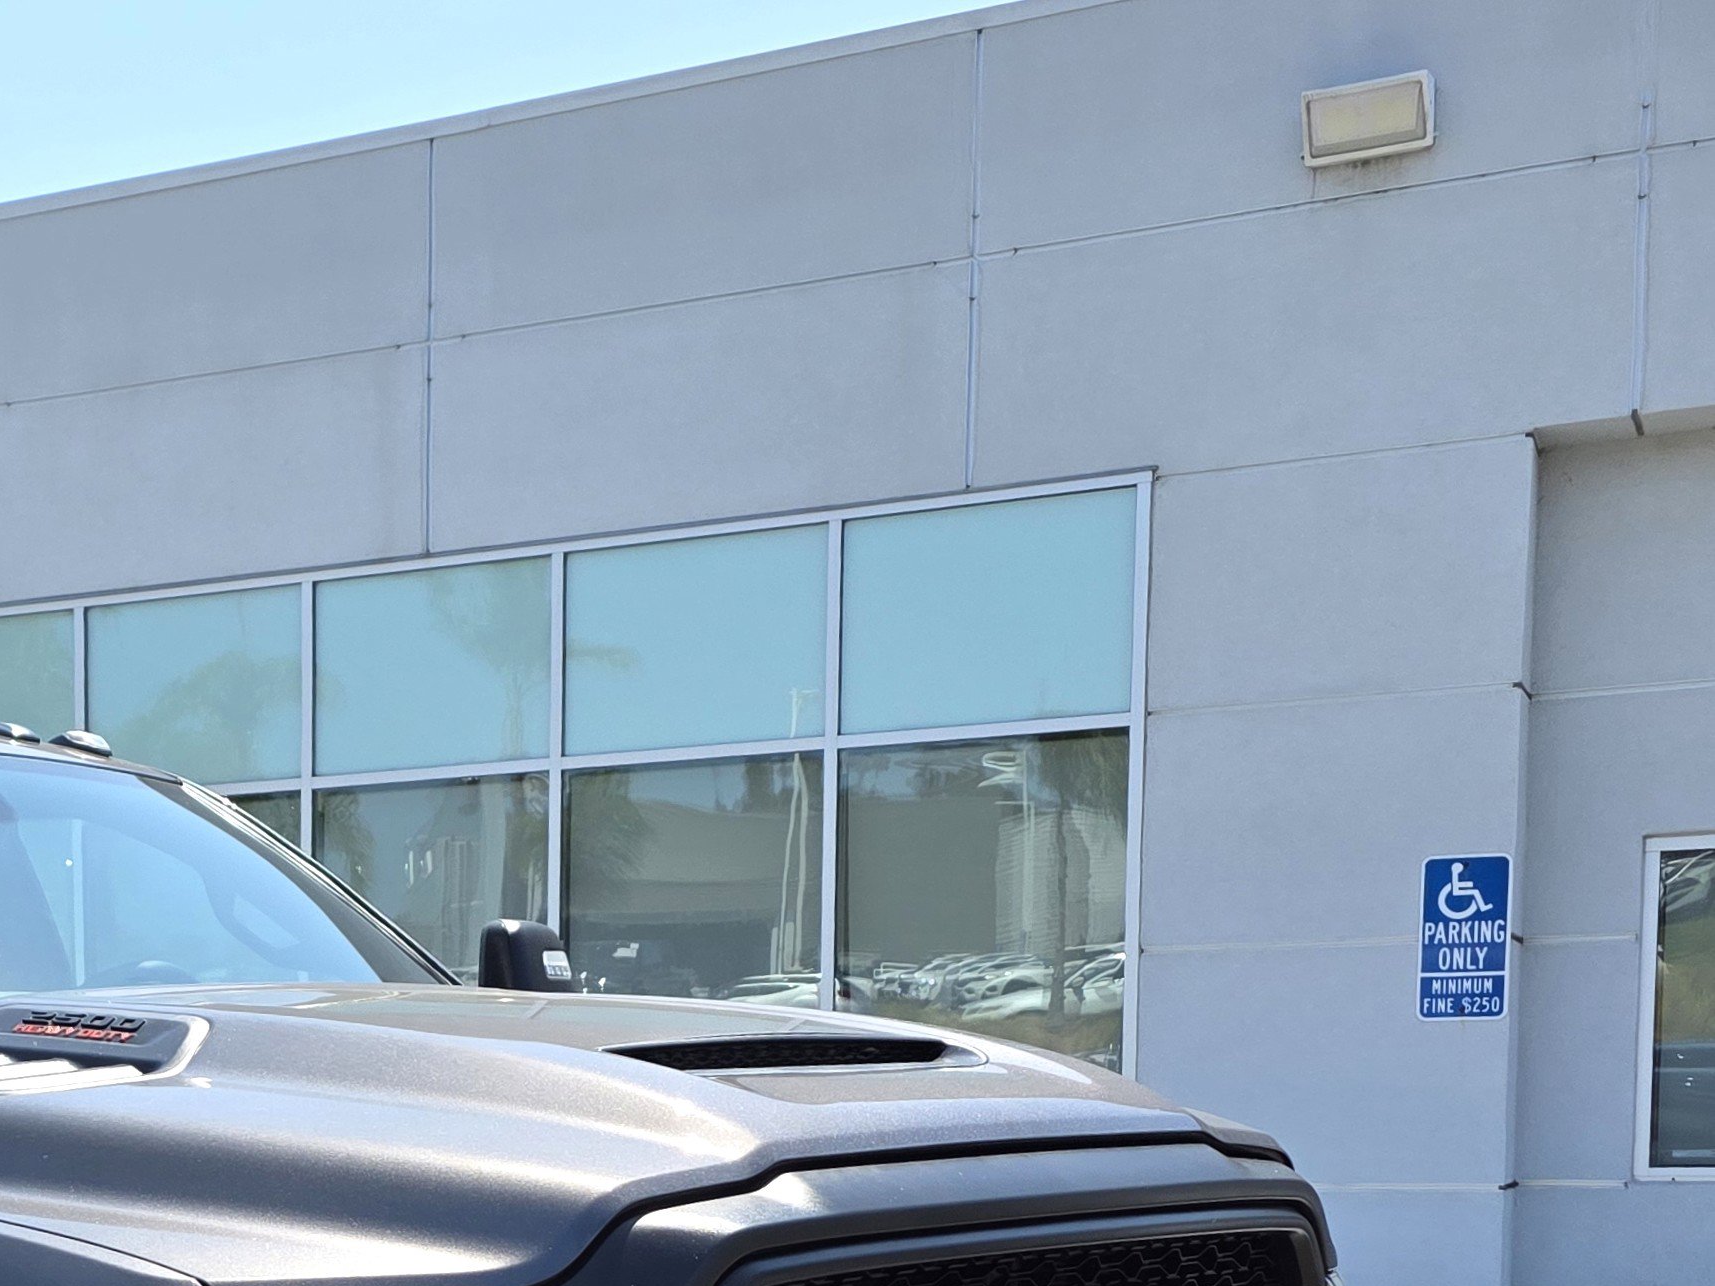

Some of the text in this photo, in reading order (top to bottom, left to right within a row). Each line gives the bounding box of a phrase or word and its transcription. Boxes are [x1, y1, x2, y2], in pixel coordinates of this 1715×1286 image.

[1424, 919, 1505, 944] PARKING
[1438, 947, 1487, 971] ONLY
[1431, 978, 1493, 995] MINIMUM
[1423, 996, 1500, 1014] FINE $250
[22, 1010, 147, 1032] 2500
[76, 1028, 136, 1043] DUTY
